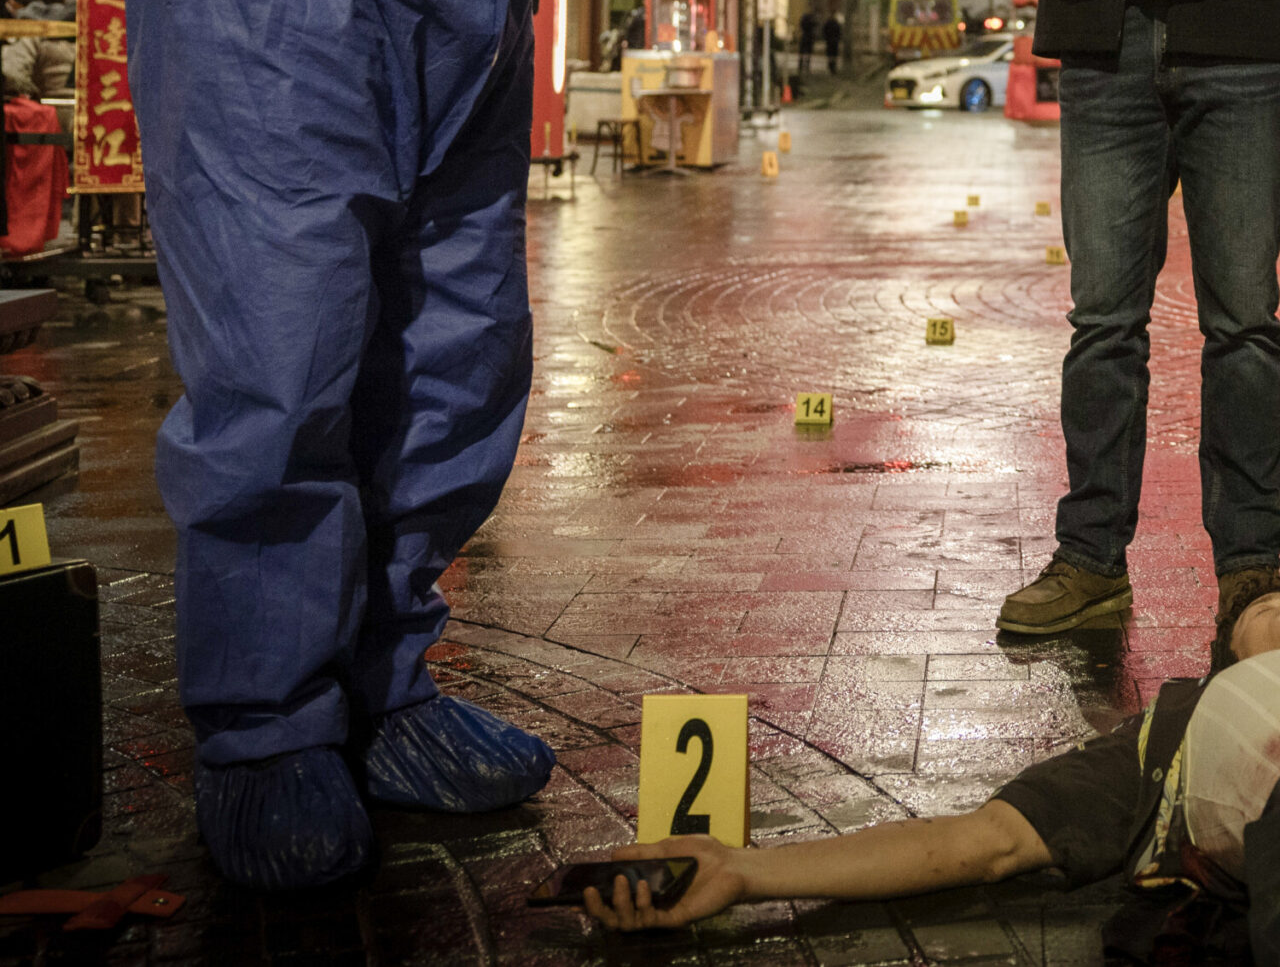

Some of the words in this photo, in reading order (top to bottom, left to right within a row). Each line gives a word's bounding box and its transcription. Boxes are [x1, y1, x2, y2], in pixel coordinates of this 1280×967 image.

[931, 322, 949, 336] 15
[802, 398, 826, 418] 14
[0, 519, 20, 565] 1
[670, 718, 714, 835] 2
